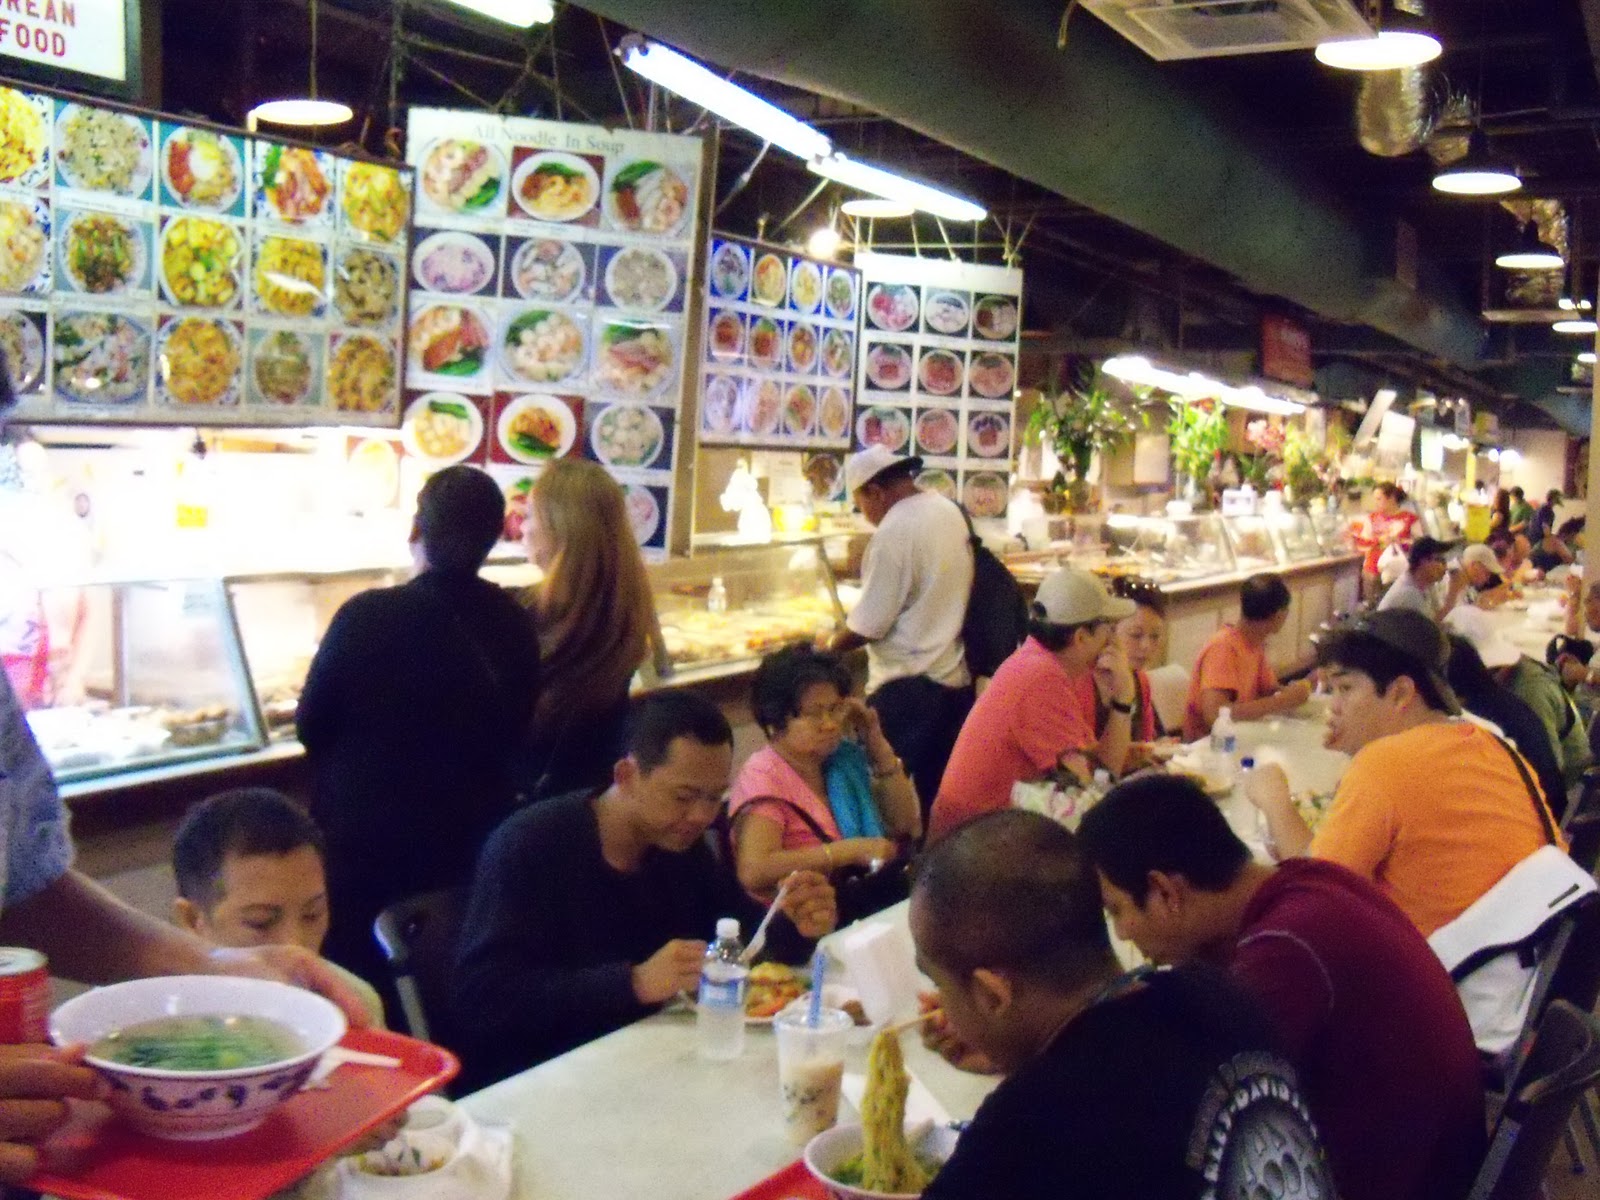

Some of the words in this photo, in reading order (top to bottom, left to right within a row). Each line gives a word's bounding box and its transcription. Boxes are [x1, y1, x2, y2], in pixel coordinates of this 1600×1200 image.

[0, 18, 65, 57] FOOD
[476, 124, 495, 139] All
[503, 127, 557, 146] Noodle
[566, 133, 580, 149] In
[587, 135, 625, 156] Soup
